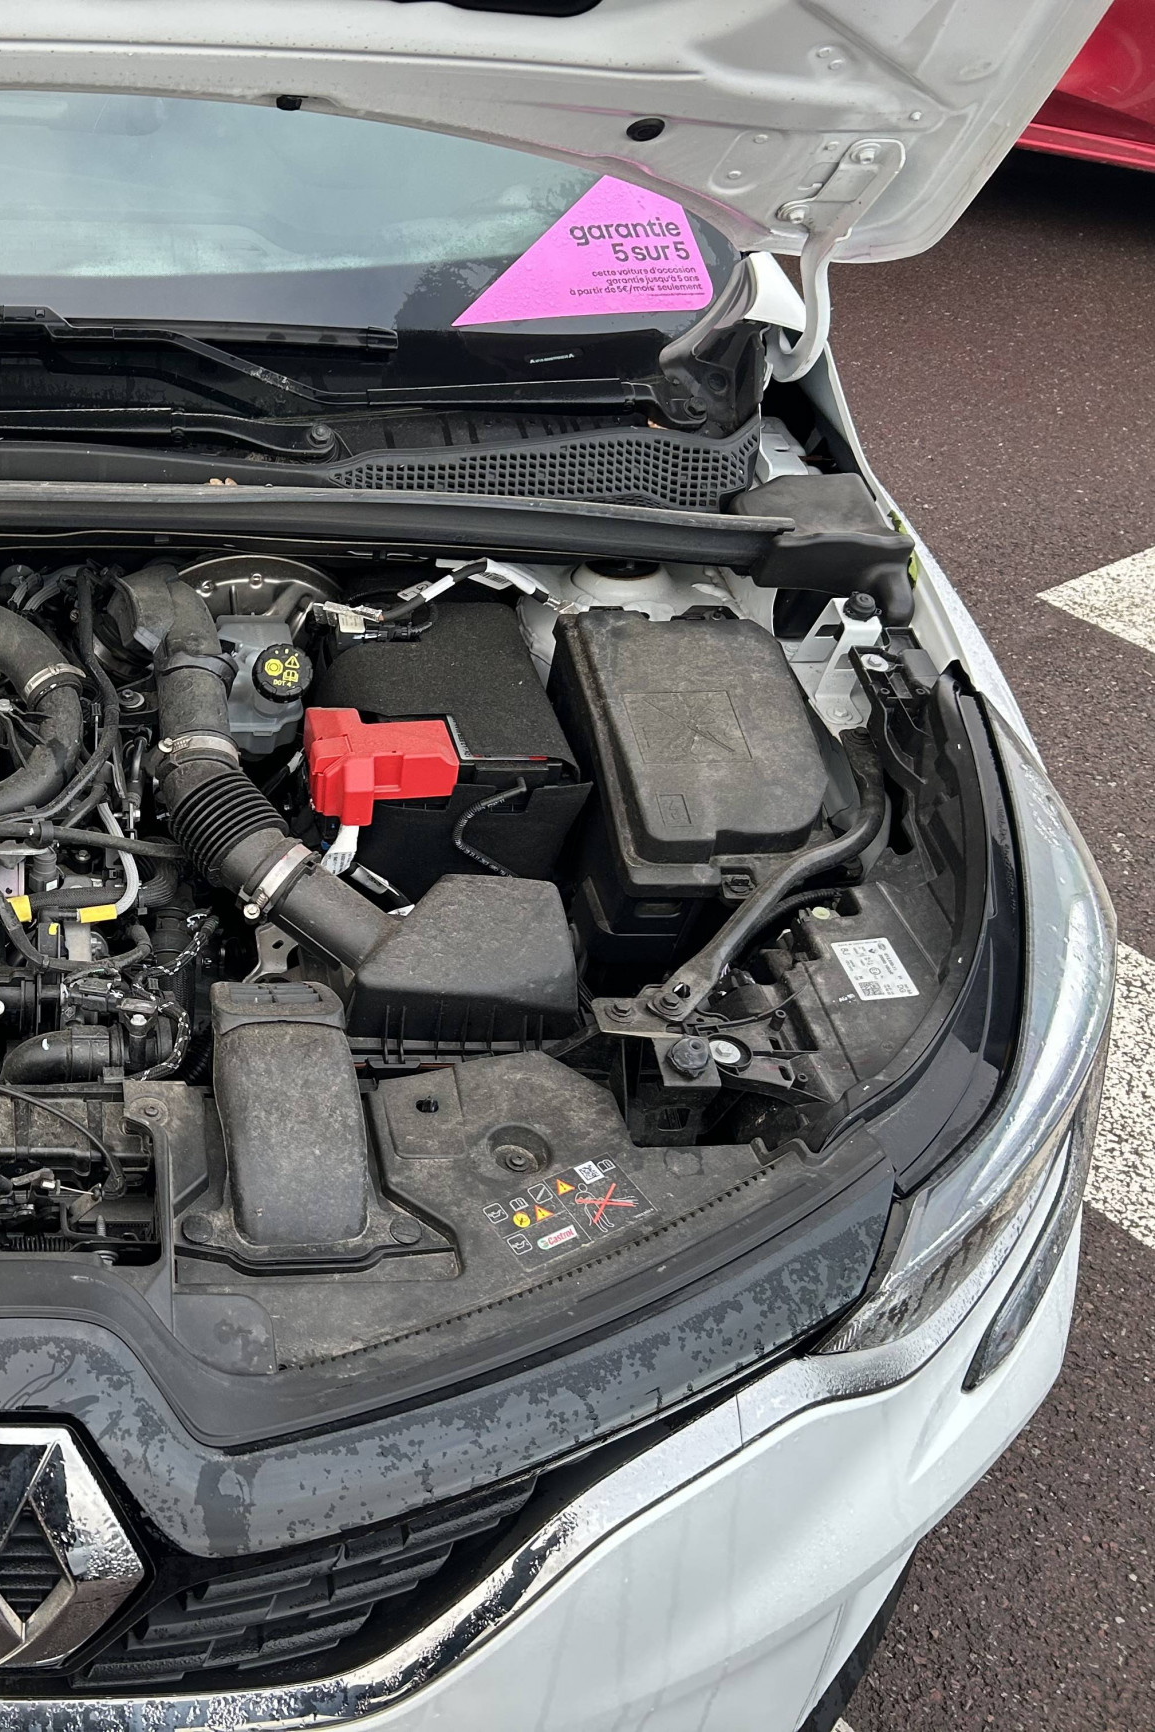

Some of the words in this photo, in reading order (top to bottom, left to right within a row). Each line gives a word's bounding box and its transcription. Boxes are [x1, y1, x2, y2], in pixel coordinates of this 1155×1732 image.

[569, 217, 681, 246] garantie
[611, 242, 629, 262] 5
[631, 245, 670, 262] sur
[672, 241, 690, 261] 5
[649, 266, 697, 275] d'occasion
[606, 276, 644, 286] garantie
[645, 275, 677, 285] jusqu'à
[569, 288, 577, 296] à
[577, 286, 603, 297] partir
[604, 286, 618, 294] de
[657, 283, 703, 291] seulement
[547, 1228, 575, 1246] Castrol
